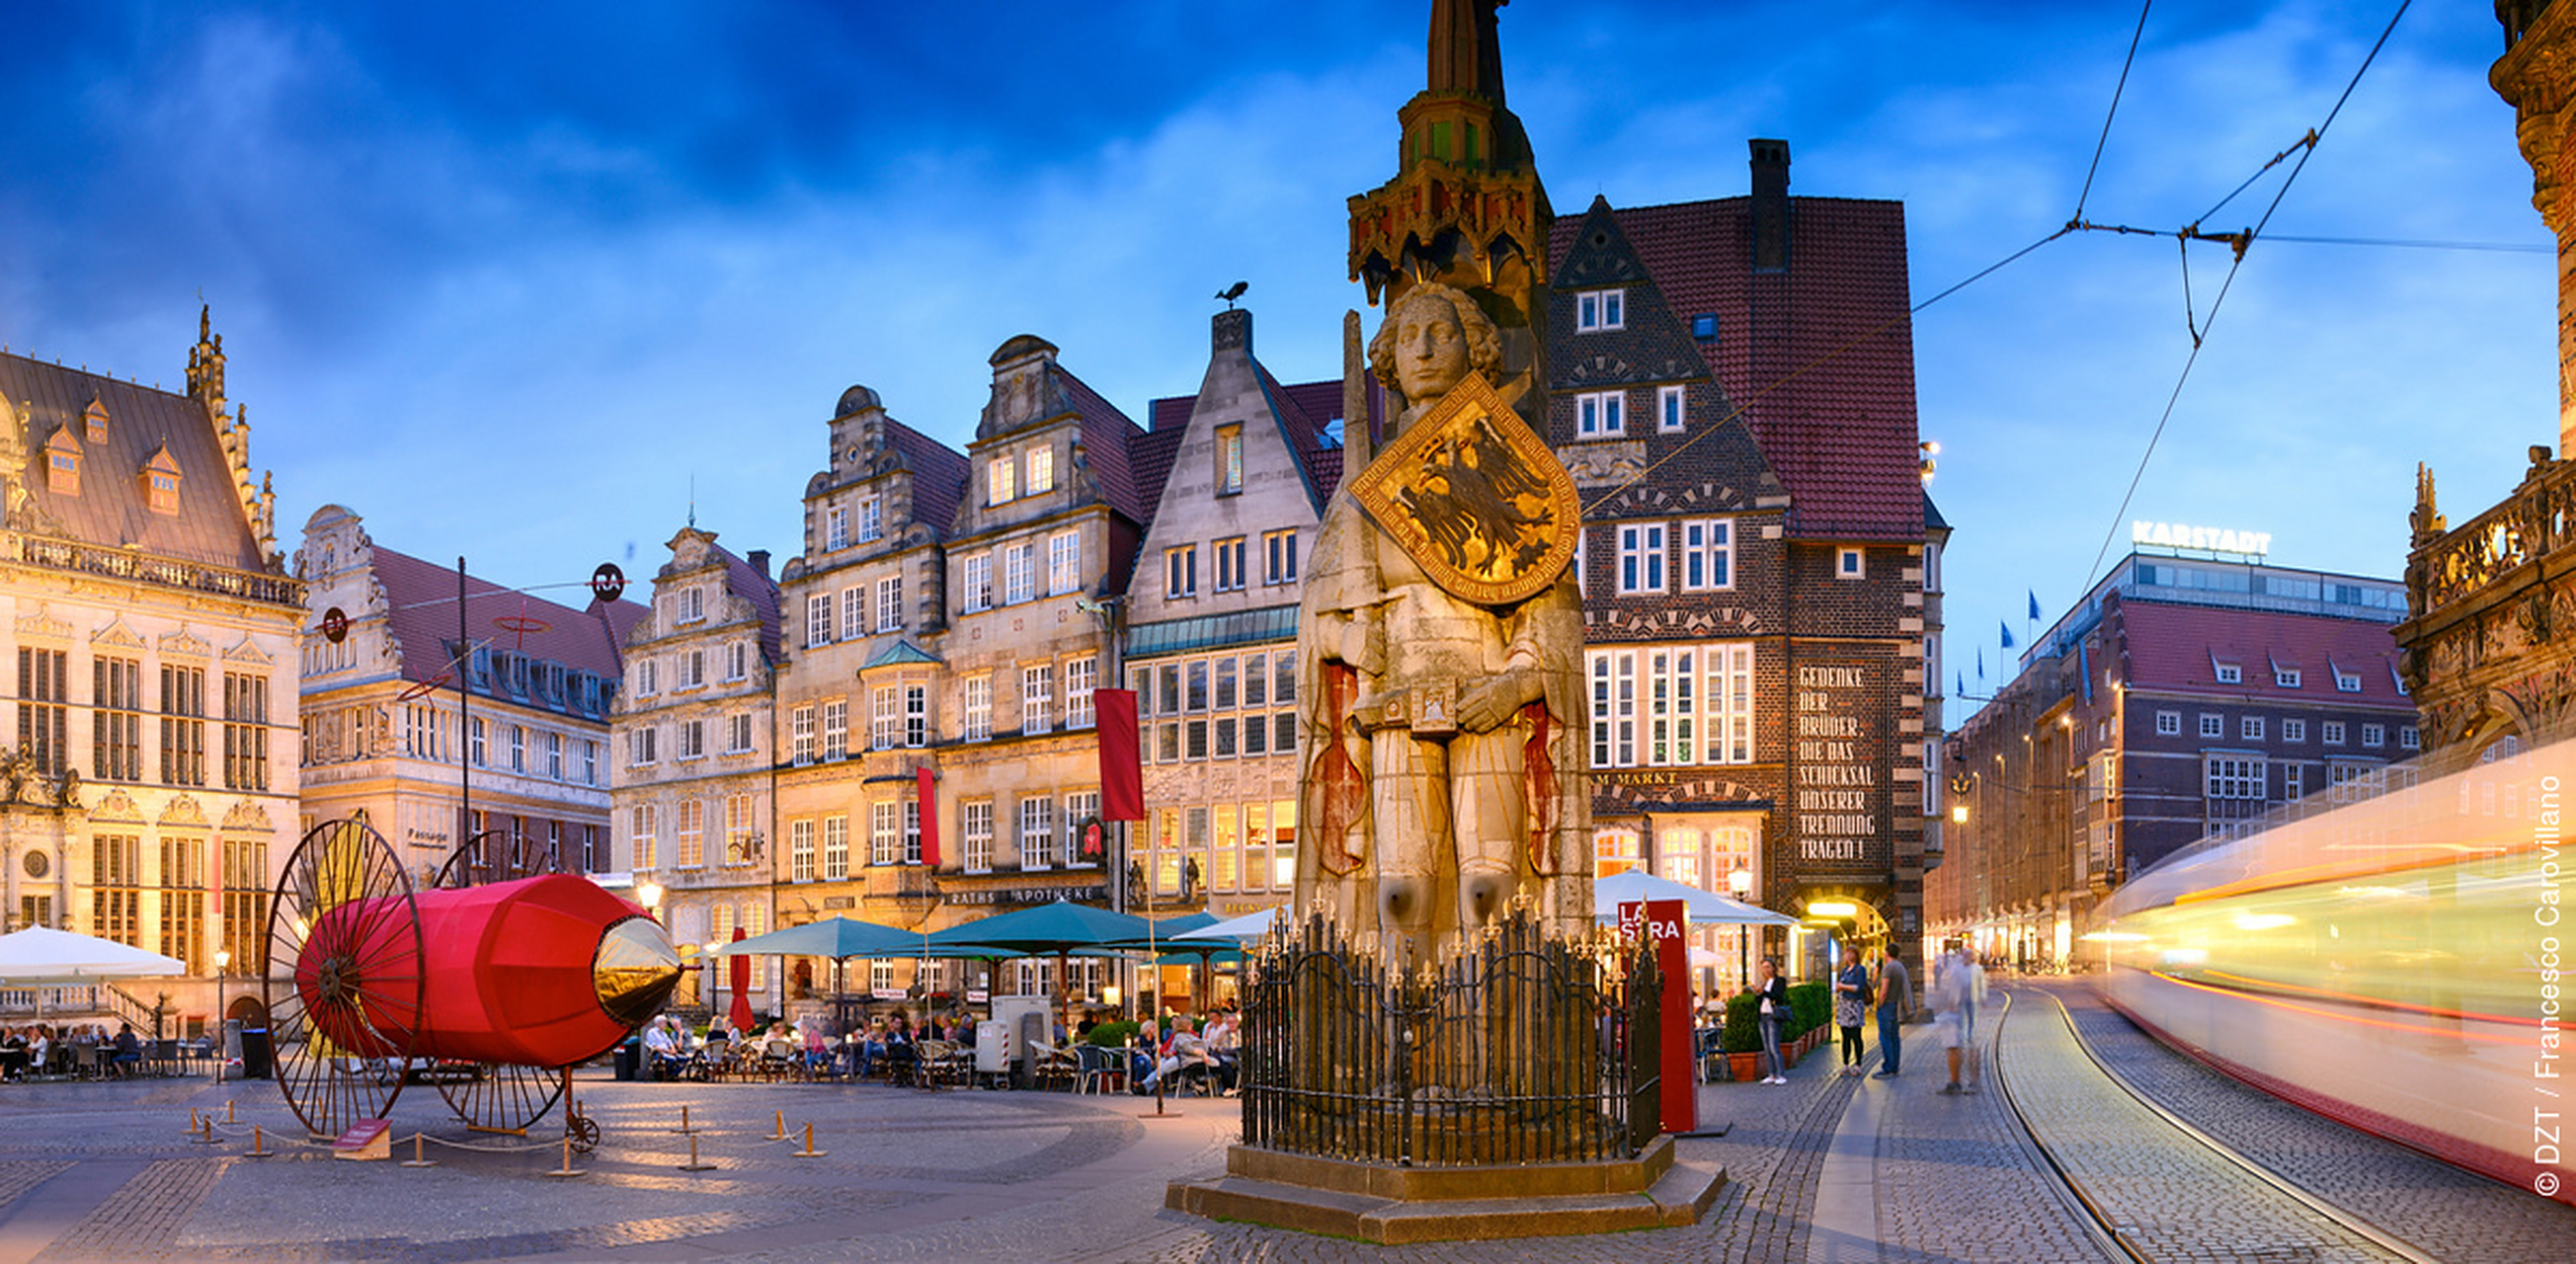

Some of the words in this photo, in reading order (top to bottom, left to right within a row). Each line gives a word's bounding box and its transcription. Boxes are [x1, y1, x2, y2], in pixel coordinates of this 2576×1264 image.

[2133, 520, 2271, 554] KARSTADT
[1800, 667, 1864, 687] GEDENKE
[1800, 692, 1828, 711] DER
[1800, 742, 1826, 760] DIE
[1827, 742, 1854, 760] DAS
[1617, 772, 1677, 784] MARKT
[1801, 765, 1875, 785] SCHICKSAL
[1800, 791, 1865, 810] UNSERER
[1801, 815, 1875, 834] TRENNUNG
[951, 892, 996, 905] RATHS
[1621, 919, 1680, 941] SRA
